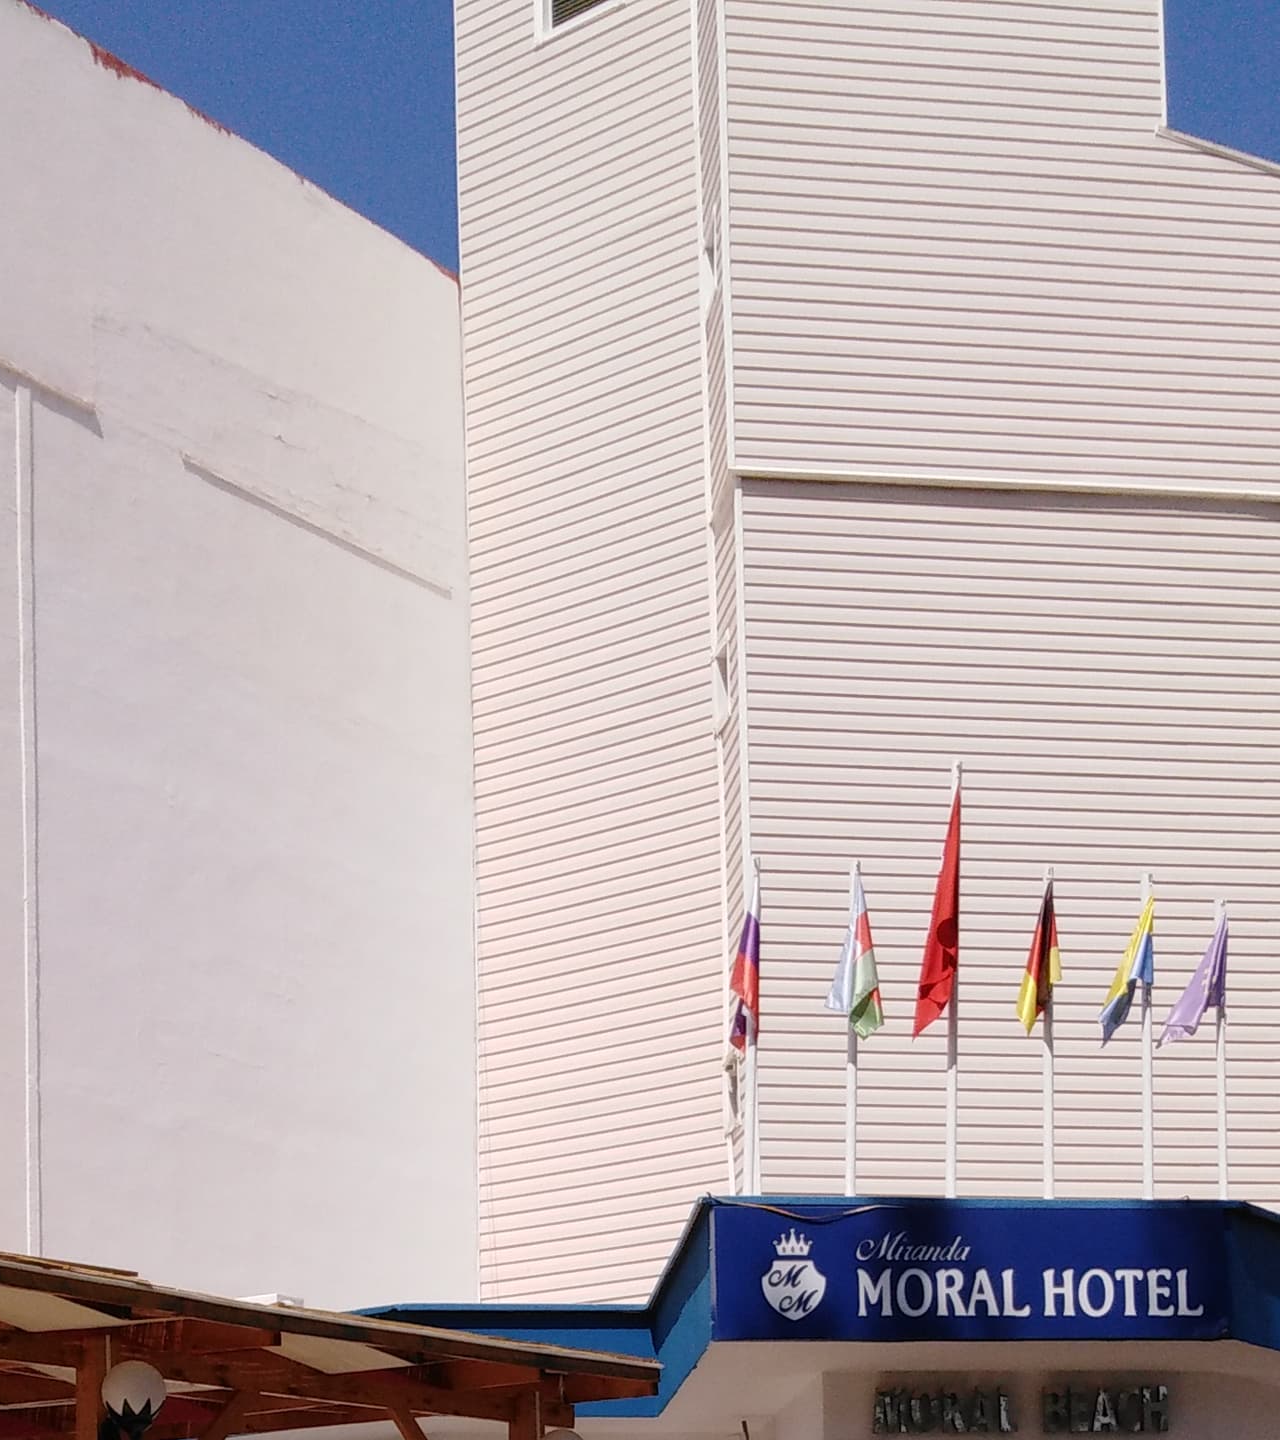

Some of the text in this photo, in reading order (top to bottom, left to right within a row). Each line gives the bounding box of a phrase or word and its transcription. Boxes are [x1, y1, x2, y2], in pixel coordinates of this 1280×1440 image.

[856, 1231, 971, 1262] Miranda
[856, 1267, 1204, 1318] MORAL HOTEL
